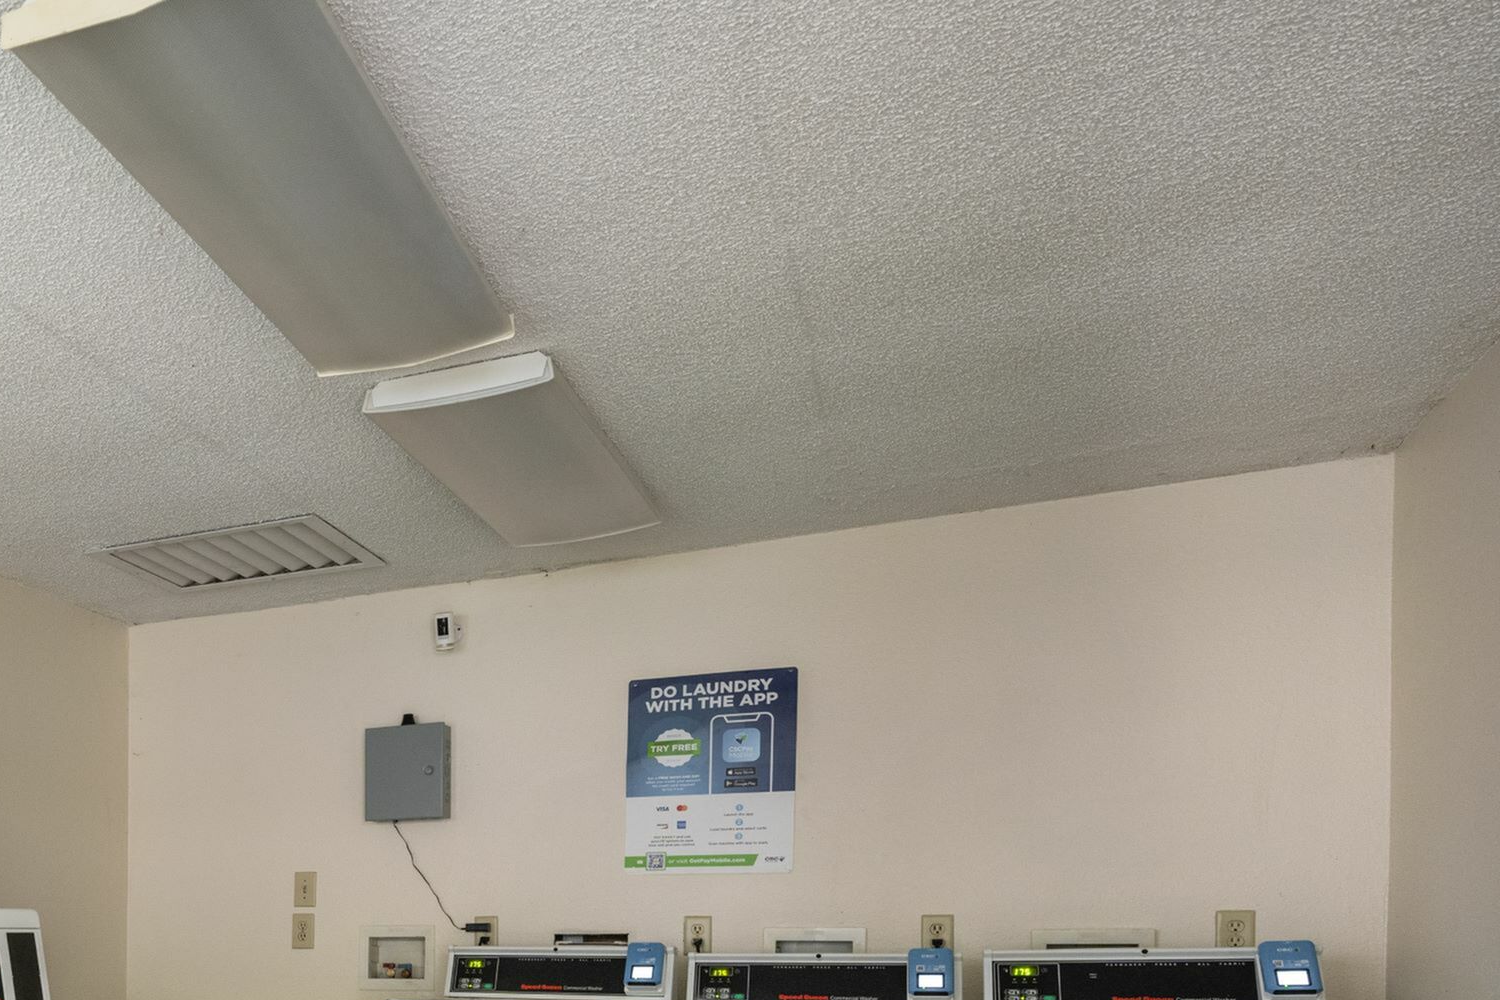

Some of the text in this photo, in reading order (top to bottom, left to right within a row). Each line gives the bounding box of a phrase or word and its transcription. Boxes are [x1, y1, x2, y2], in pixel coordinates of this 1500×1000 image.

[651, 678, 773, 699] DO LAUNDRY
[646, 692, 778, 713] WITH THE APP
[650, 743, 698, 752] TRY FREE
